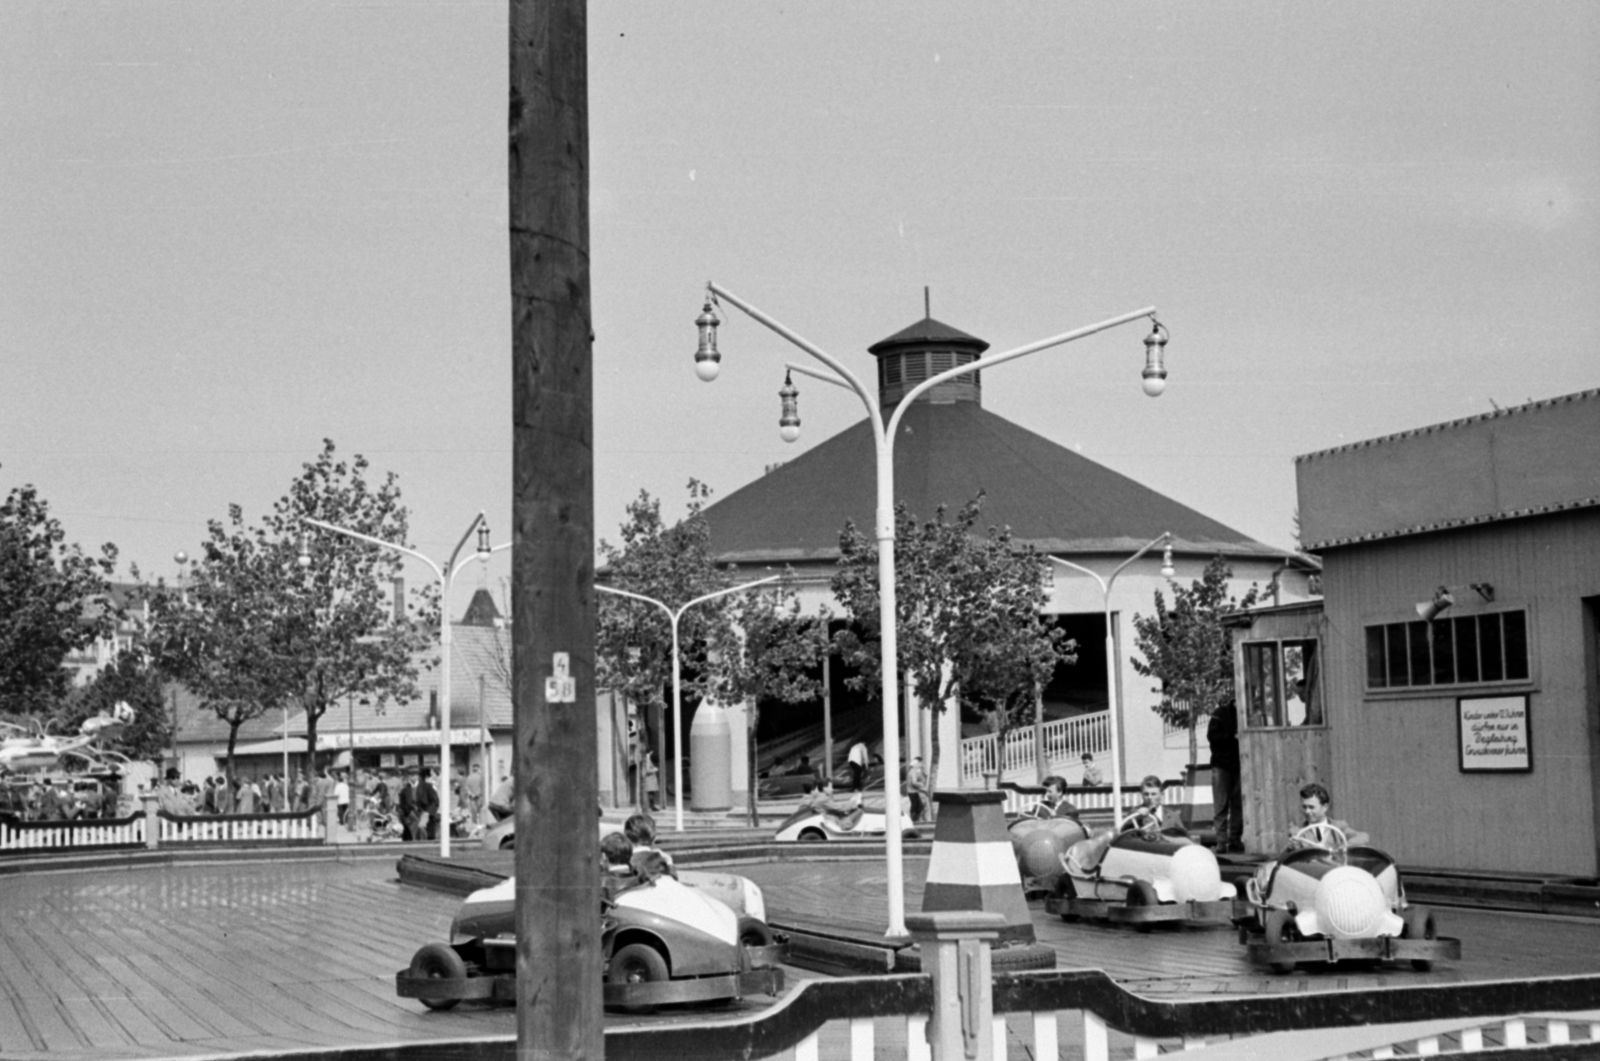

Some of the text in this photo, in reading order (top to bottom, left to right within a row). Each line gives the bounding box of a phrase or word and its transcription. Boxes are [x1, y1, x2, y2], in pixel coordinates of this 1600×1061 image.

[556, 658, 566, 672] 4
[549, 681, 572, 697] 58
[1463, 710, 1482, 720] Kinder
[1510, 723, 1519, 731] in
[1474, 732, 1518, 746] Begleitung
